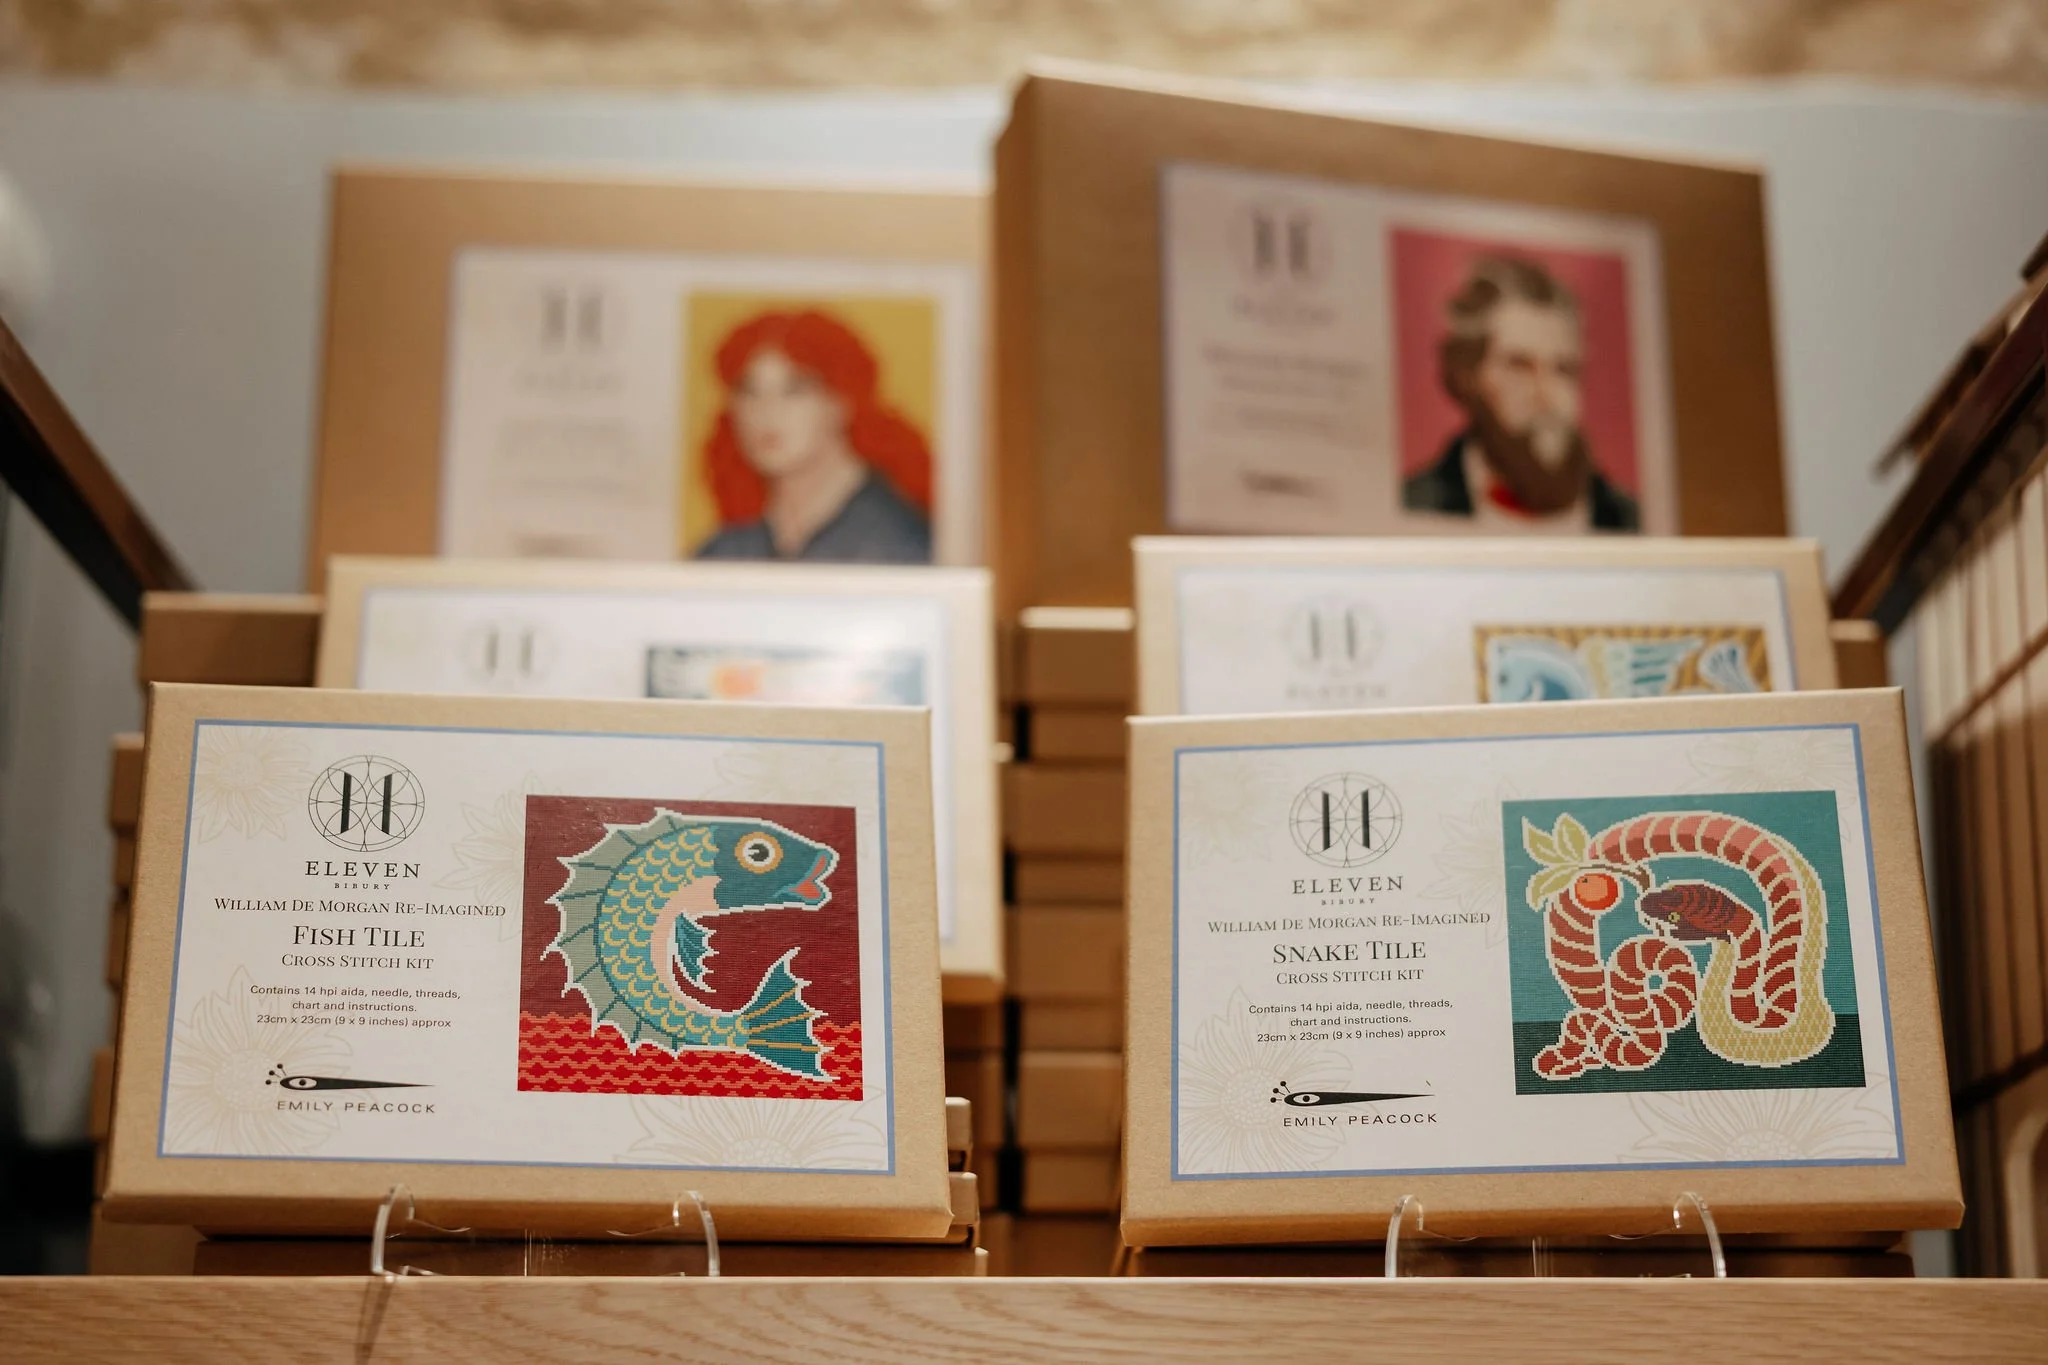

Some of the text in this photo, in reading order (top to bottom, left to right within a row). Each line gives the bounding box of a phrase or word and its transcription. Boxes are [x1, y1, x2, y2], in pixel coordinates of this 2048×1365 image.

[305, 861, 421, 878] ELEVEN
[334, 882, 391, 890] BIBURY
[1292, 875, 1404, 895] ELEVEN
[1321, 898, 1376, 906] BIBURY
[250, 985, 462, 1000] Contains 14 hpi aida, needle, threads,
[292, 1001, 417, 1012] chart and instructions.
[1248, 999, 1454, 1014] Contains 14 hpi aida, needle, threads,
[256, 1014, 287, 1024] 23cm
[300, 1015, 332, 1025] 23cm
[334, 1015, 346, 1026] (9
[368, 1016, 409, 1028] inches)
[411, 1019, 452, 1029] approx
[1290, 1014, 1412, 1027] chart and instructions.
[1257, 1033, 1287, 1043] 23cm
[1299, 1031, 1329, 1041] 23cm
[1332, 1031, 1343, 1042] (9
[1365, 1028, 1405, 1040] inches)
[1407, 1028, 1446, 1039] approx
[277, 1100, 436, 1114] EMILY PEACOCK
[1283, 1113, 1438, 1127] EMILY PEACOCK
